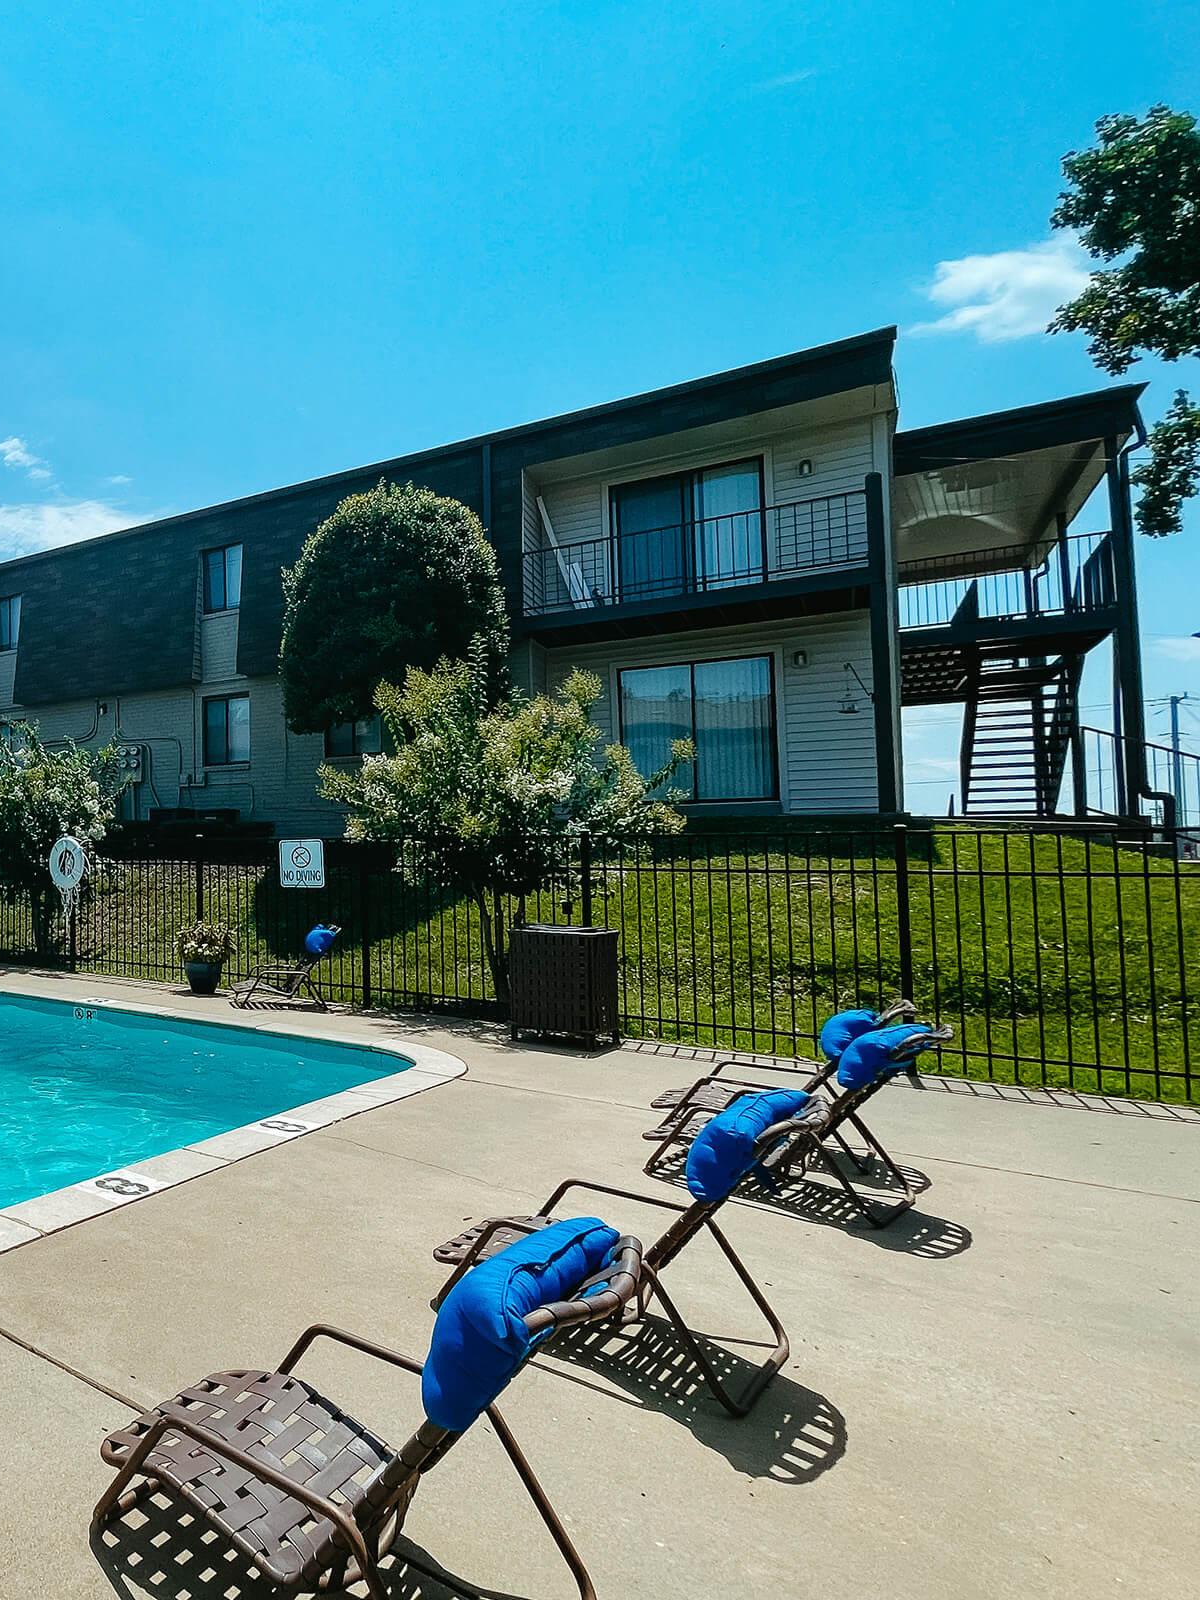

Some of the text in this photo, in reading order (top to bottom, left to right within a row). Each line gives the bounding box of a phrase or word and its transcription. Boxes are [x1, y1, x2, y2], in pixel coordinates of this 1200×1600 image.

[283, 870, 321, 882] NO DIVING
[95, 1177, 149, 1195] 8
